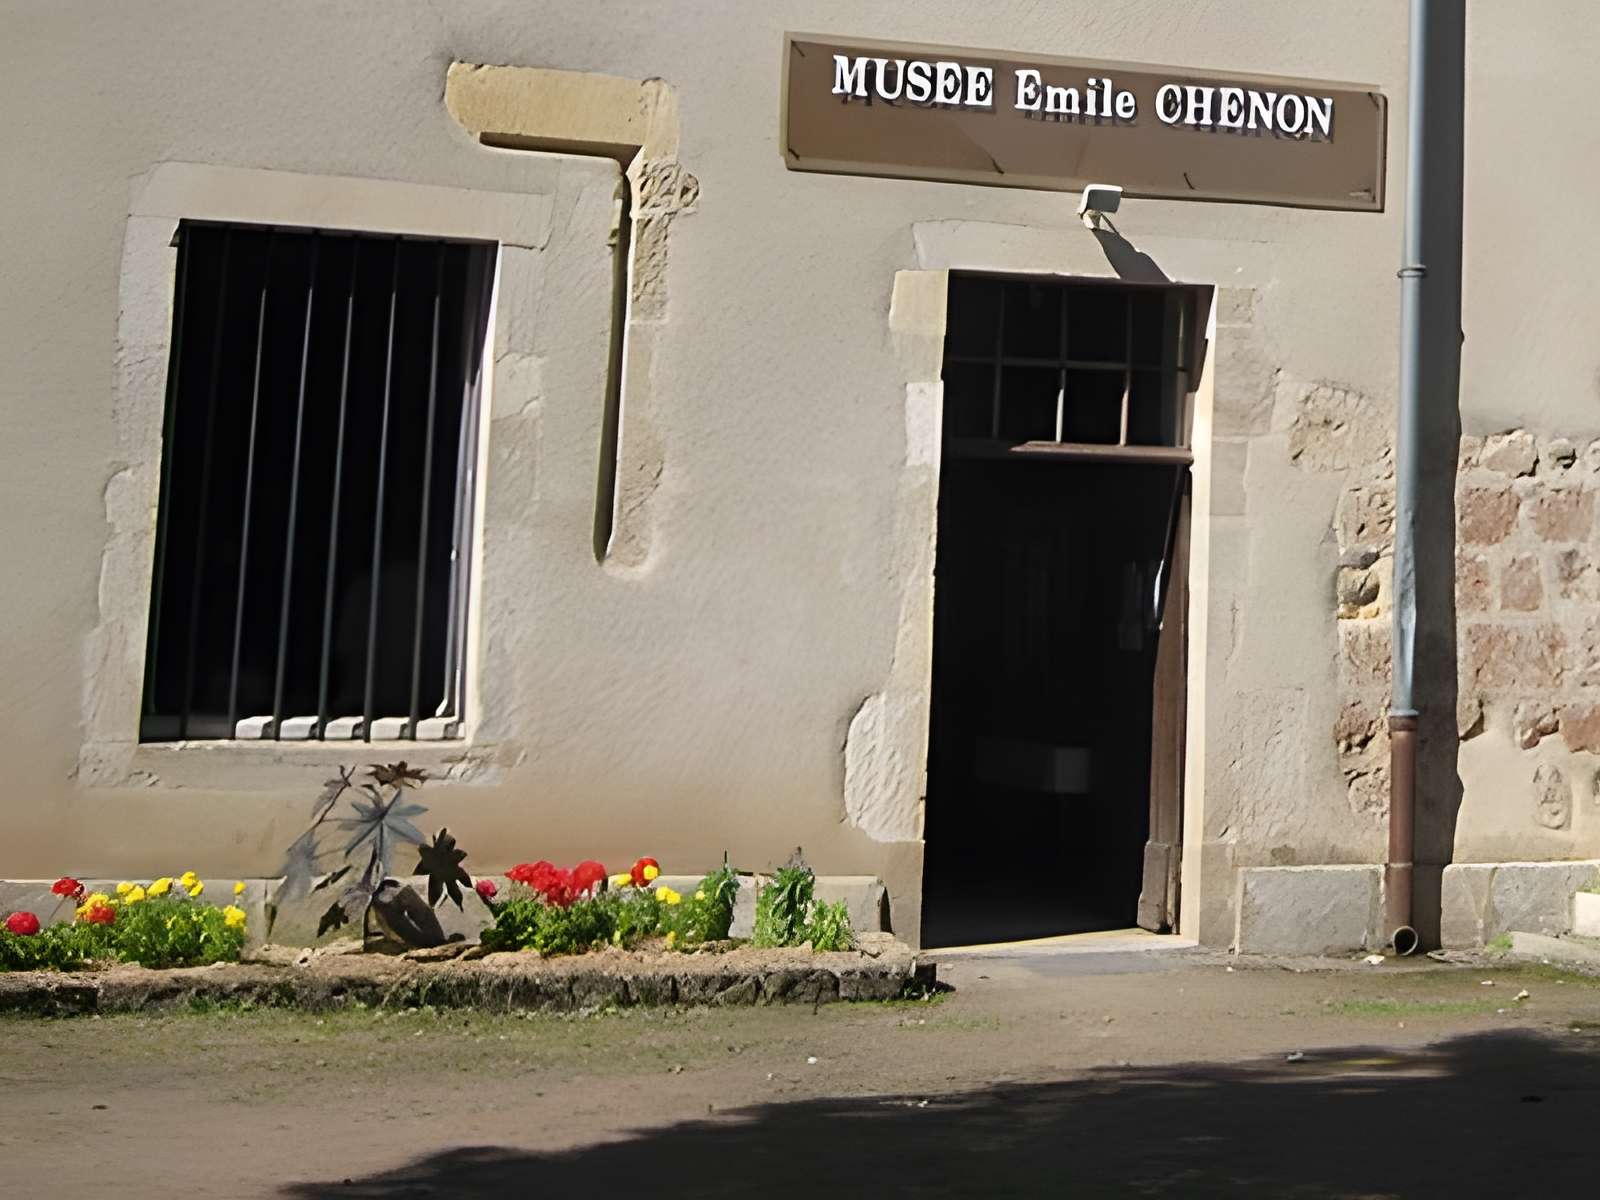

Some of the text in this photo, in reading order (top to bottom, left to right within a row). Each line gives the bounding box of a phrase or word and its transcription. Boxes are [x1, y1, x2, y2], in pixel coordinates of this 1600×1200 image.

[832, 54, 1333, 135] MUSEE Emile CHENON
